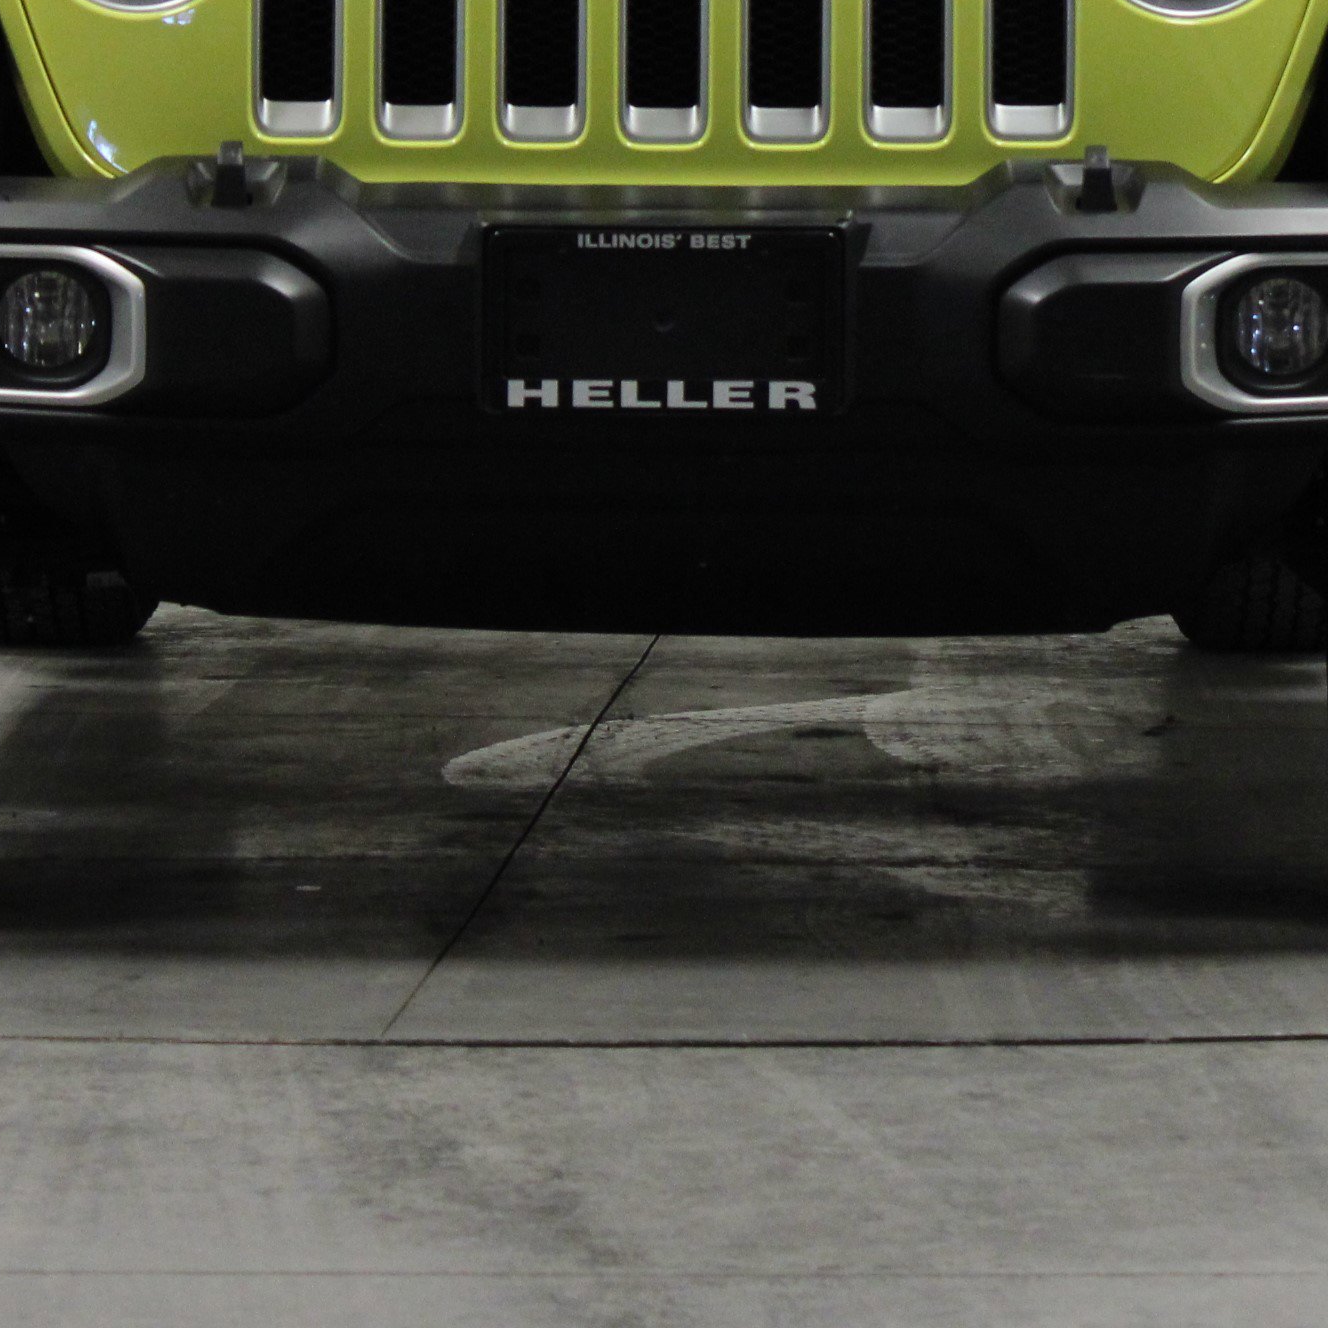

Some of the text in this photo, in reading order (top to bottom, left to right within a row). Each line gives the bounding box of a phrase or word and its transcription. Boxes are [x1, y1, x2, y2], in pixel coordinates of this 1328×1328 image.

[578, 234, 751, 249] ILLINOIS' BEST
[508, 380, 816, 409] HELLER
